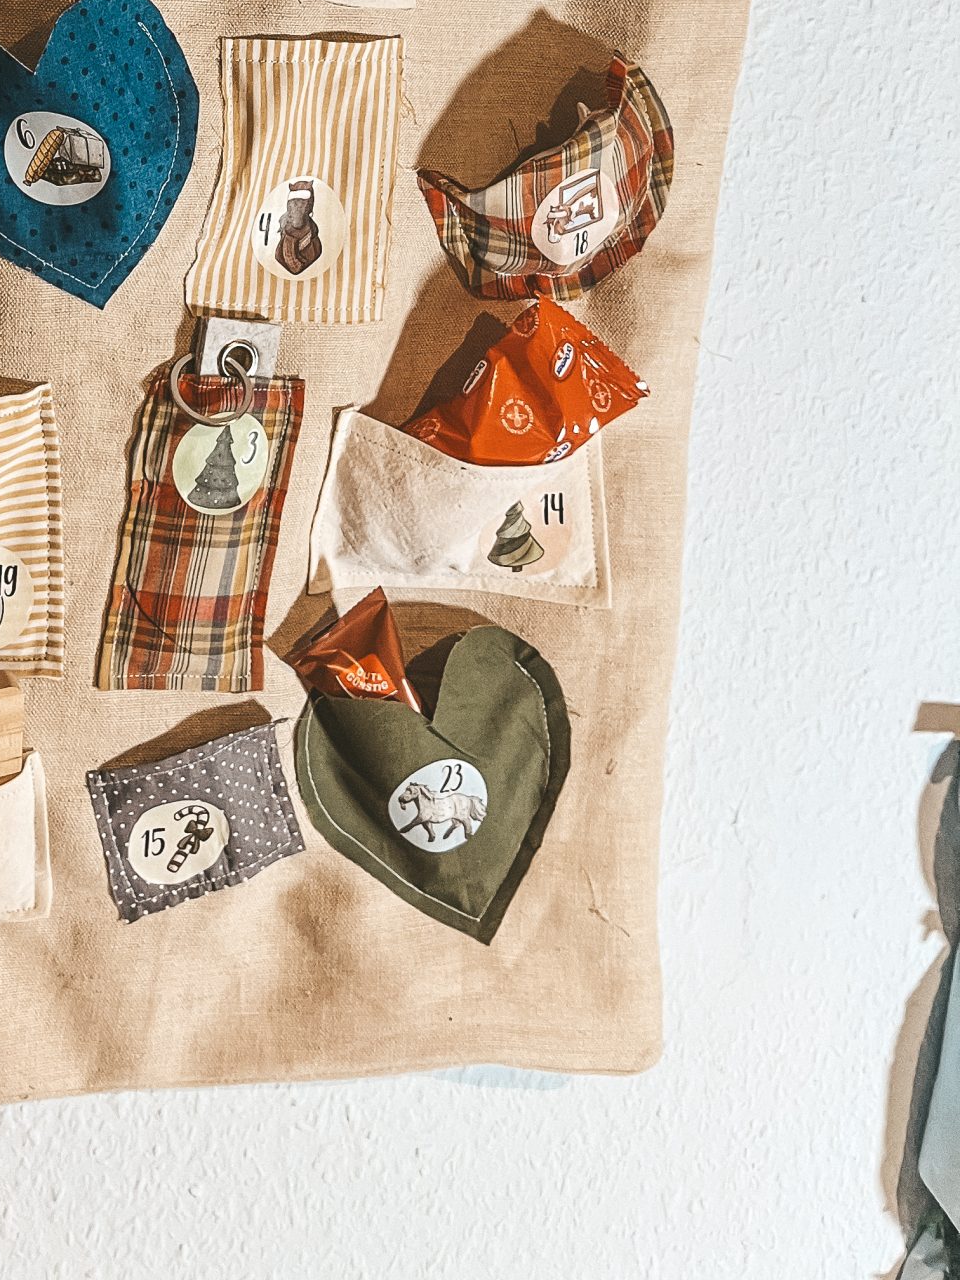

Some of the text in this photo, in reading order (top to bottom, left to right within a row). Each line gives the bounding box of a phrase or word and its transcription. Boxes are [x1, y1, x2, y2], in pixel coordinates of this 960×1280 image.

[17, 119, 35, 149] 6
[259, 213, 270, 246] 4
[574, 231, 589, 256] 18
[241, 432, 258, 465] 3
[540, 493, 563, 524] 14
[440, 765, 463, 793] 23
[143, 828, 165, 857] 15
